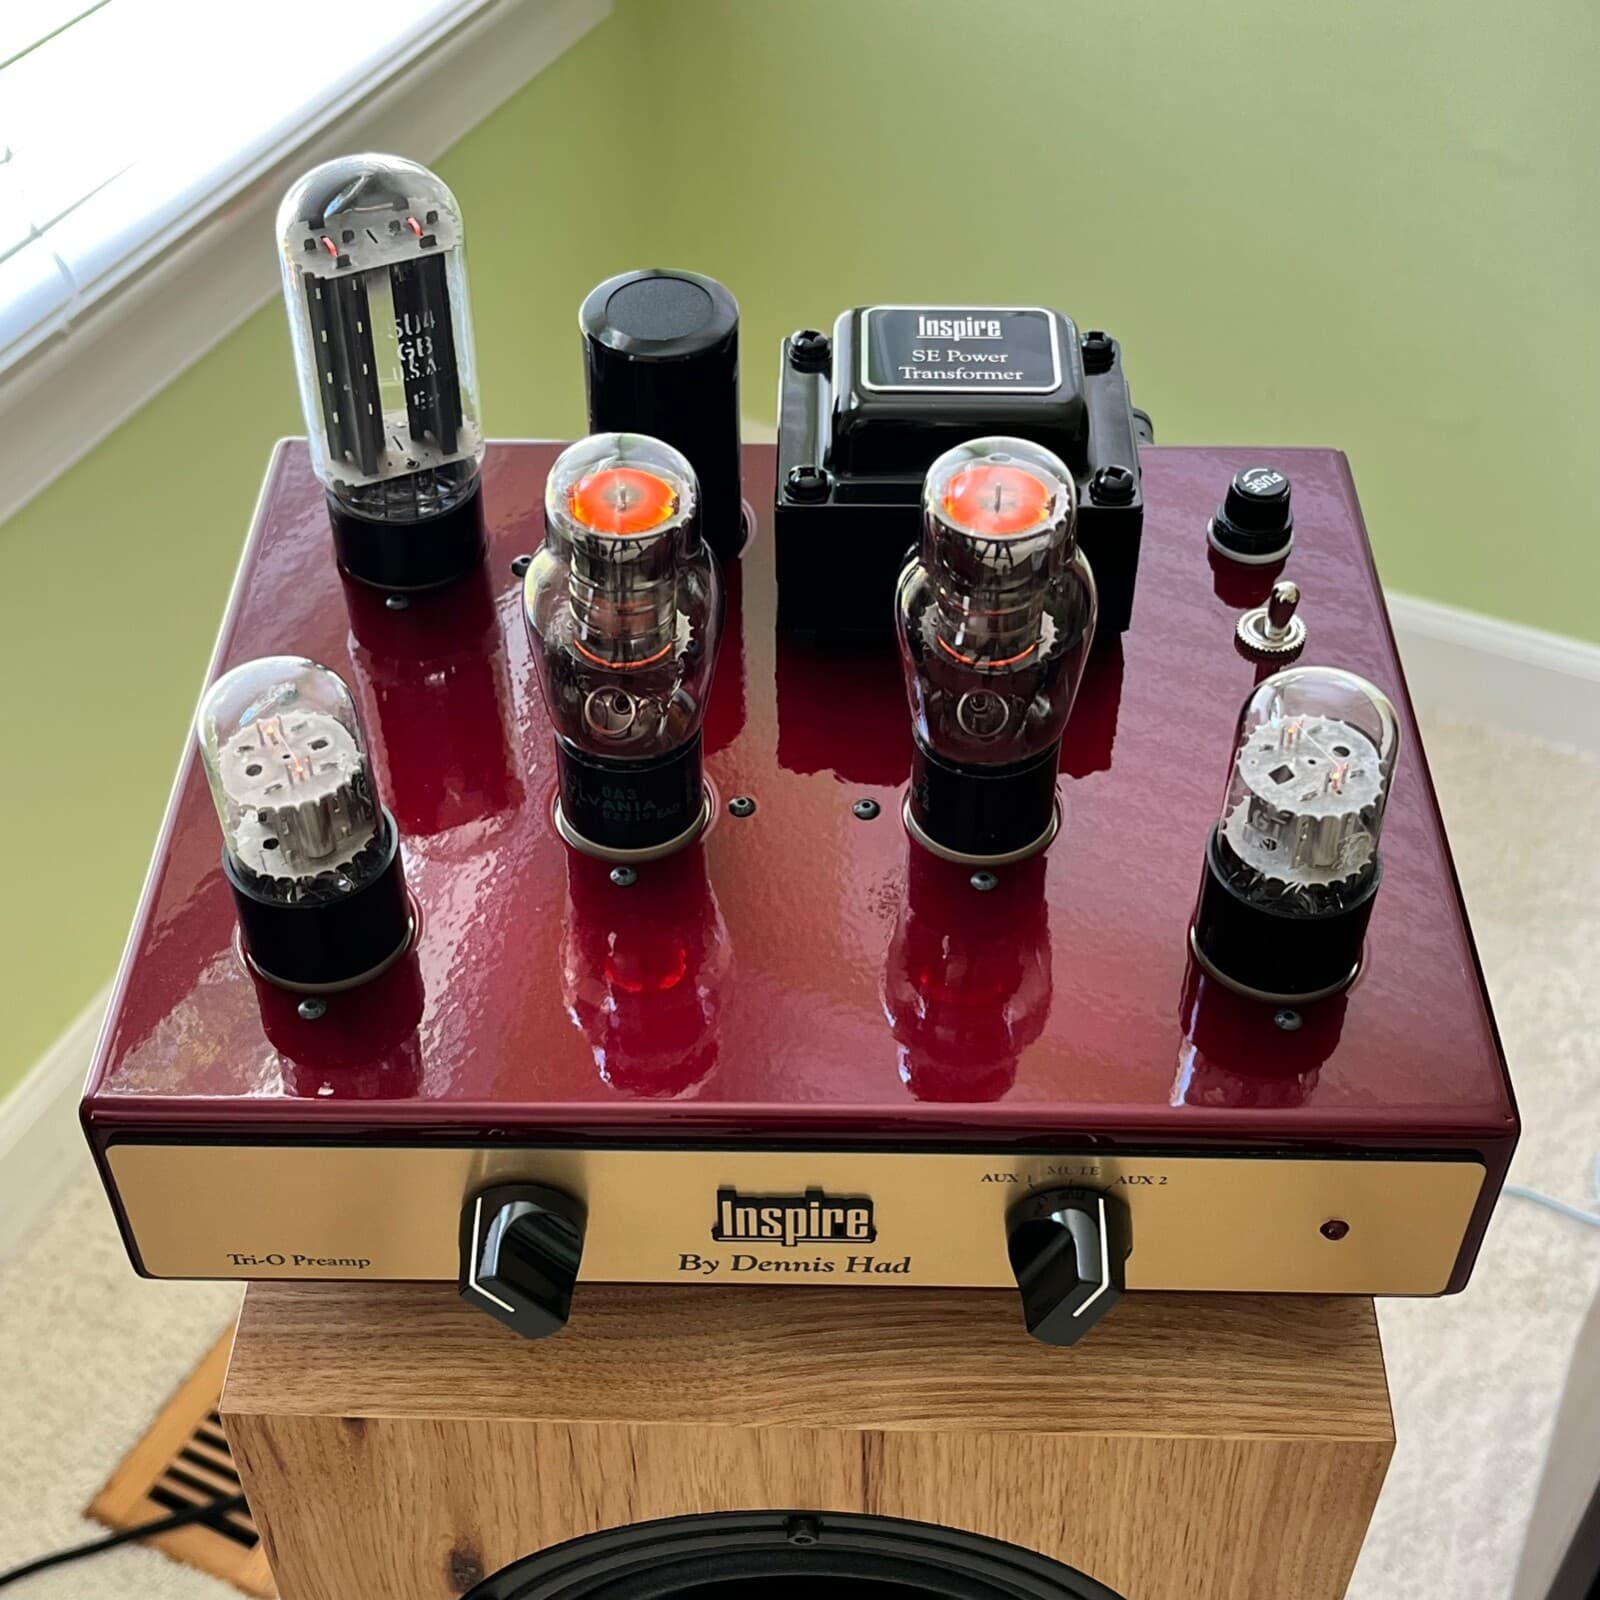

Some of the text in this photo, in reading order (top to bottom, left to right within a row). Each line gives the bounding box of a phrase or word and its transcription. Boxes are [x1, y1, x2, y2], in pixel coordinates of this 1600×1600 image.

[918, 316, 1002, 341] Inspire
[397, 336, 433, 361] GB
[911, 350, 1008, 363] SE Power
[898, 366, 1024, 380] Transformer
[1245, 472, 1284, 493] FUSE
[981, 1173, 1019, 1183] AUX
[1047, 1165, 1101, 1176] MUTE
[1114, 1175, 1168, 1185] AUX 2
[721, 1199, 871, 1247] Inspire
[226, 1253, 371, 1269] Tri-O Preamp
[678, 1253, 912, 1275] By Dennis Had
